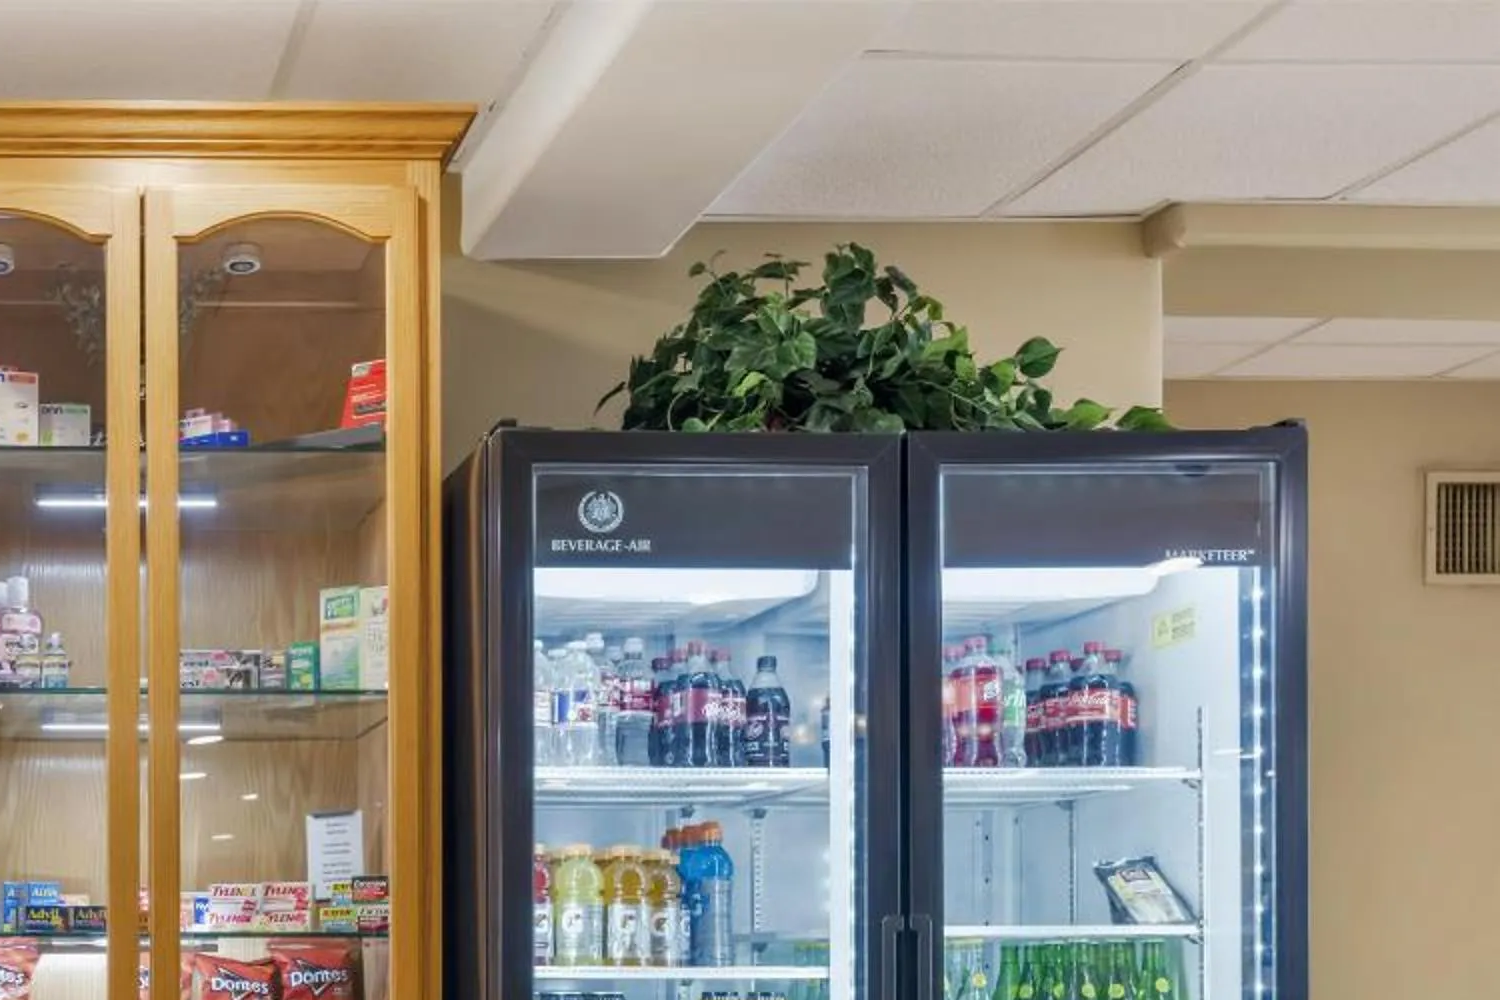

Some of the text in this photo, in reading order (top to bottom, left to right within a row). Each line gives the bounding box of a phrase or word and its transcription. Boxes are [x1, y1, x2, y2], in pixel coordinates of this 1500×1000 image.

[551, 539, 652, 552] BEVERAGE-AIR
[211, 976, 269, 995] Doritos
[290, 968, 349, 988] Doritos
